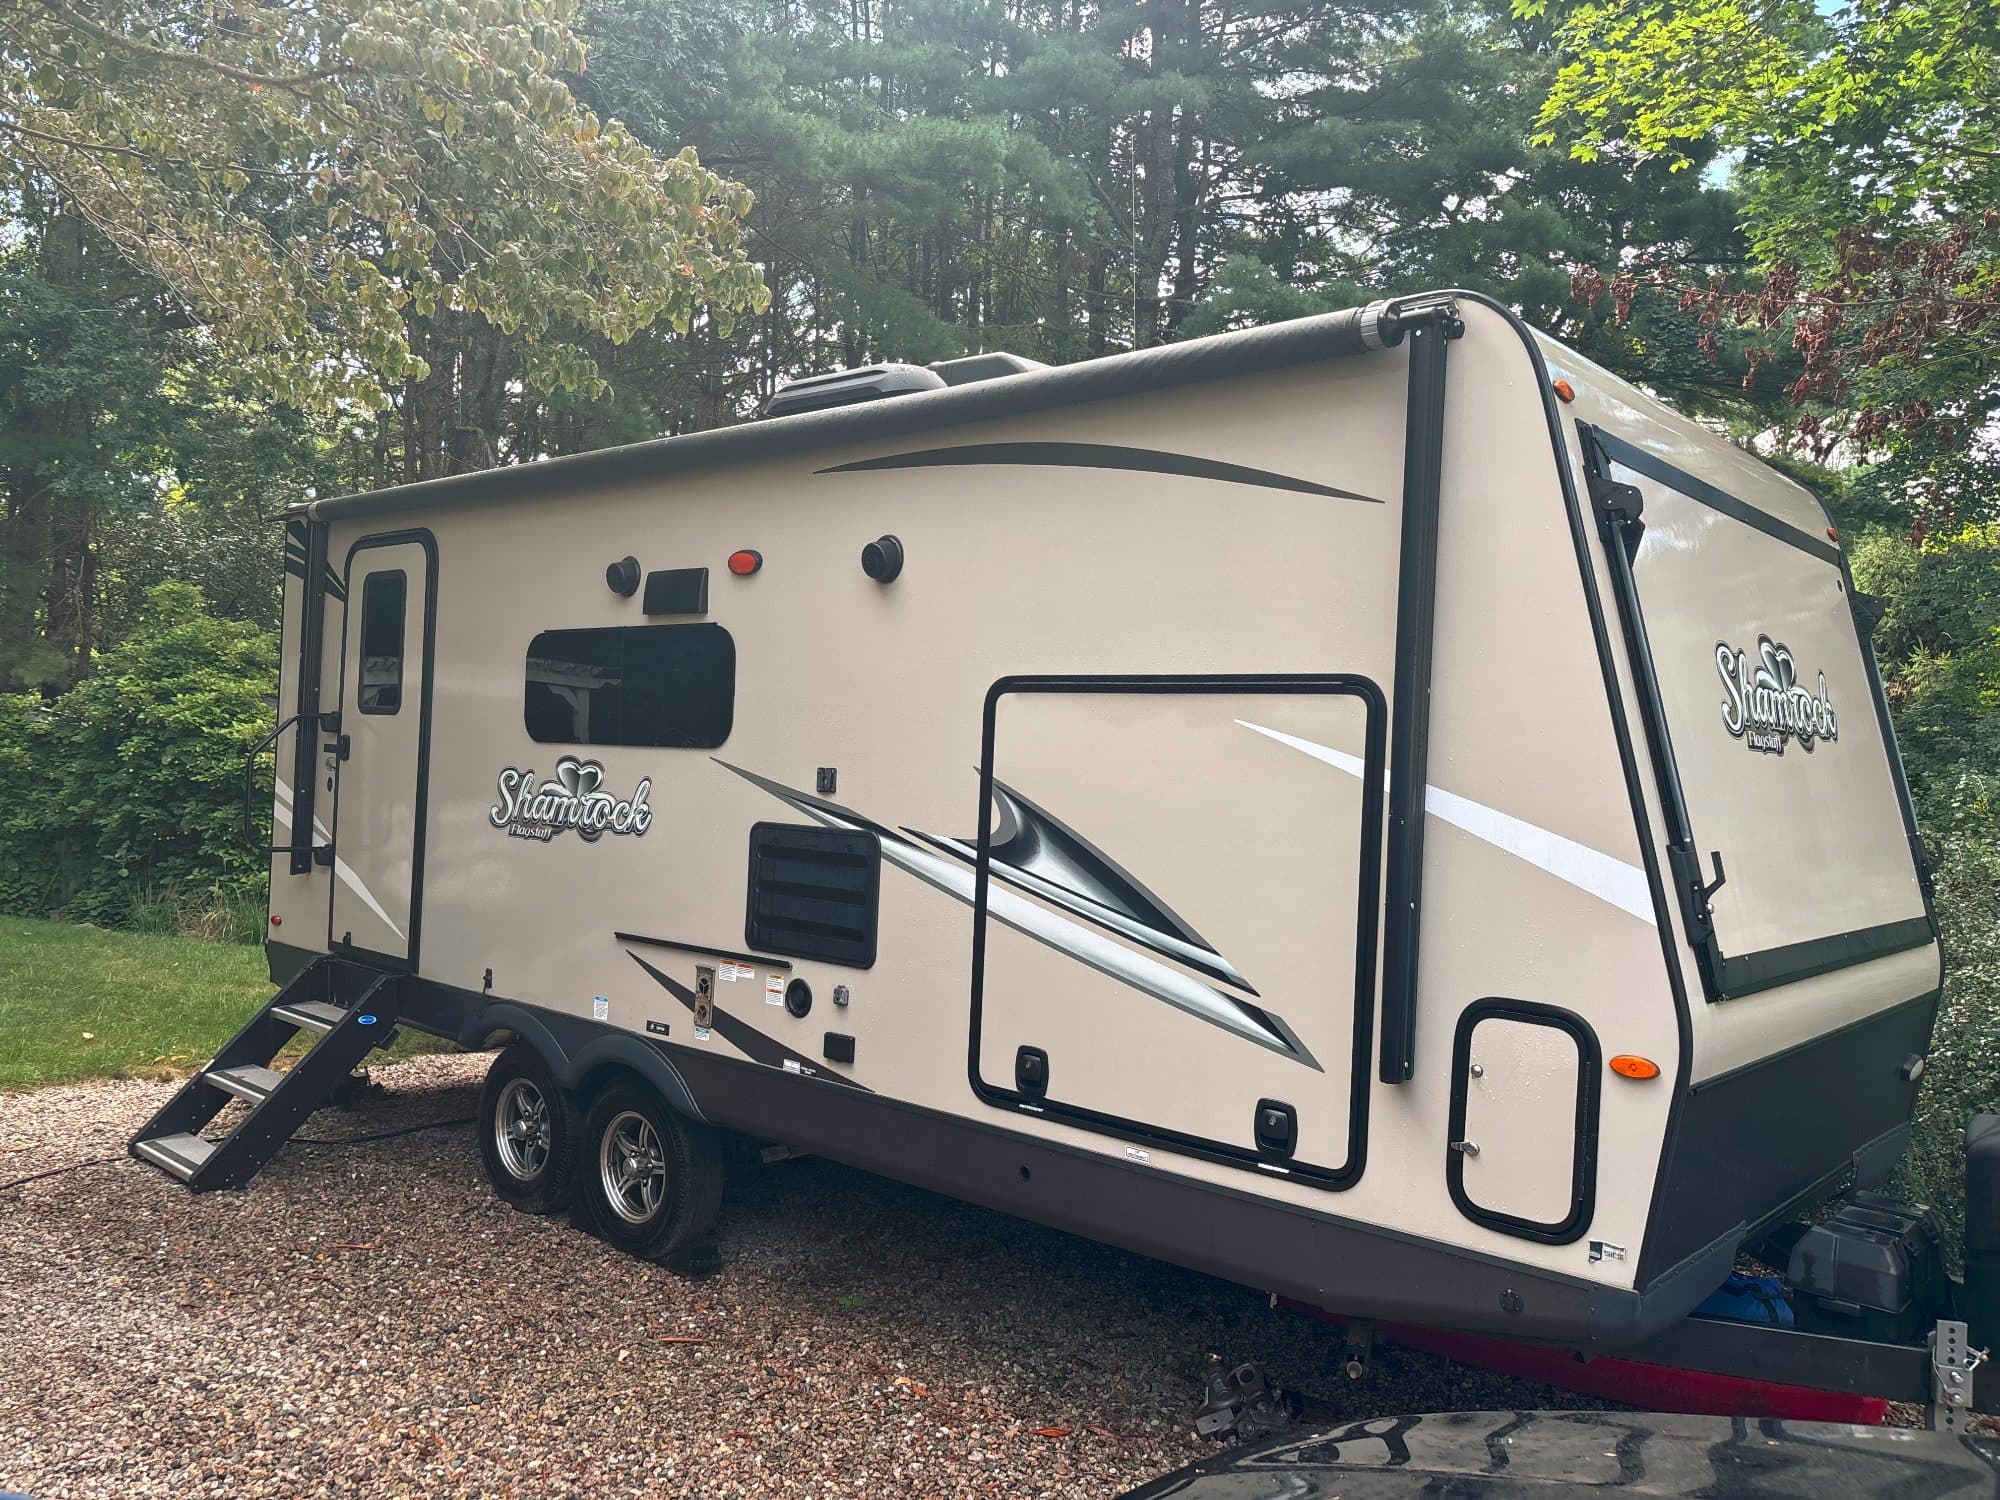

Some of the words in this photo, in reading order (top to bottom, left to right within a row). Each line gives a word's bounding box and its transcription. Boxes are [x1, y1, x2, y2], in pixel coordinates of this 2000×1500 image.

[1716, 643, 1837, 738] Shamrock
[1748, 731, 1781, 751] Flagstaff
[490, 767, 652, 835] Shamrock
[510, 823, 551, 840] Flagstaff
